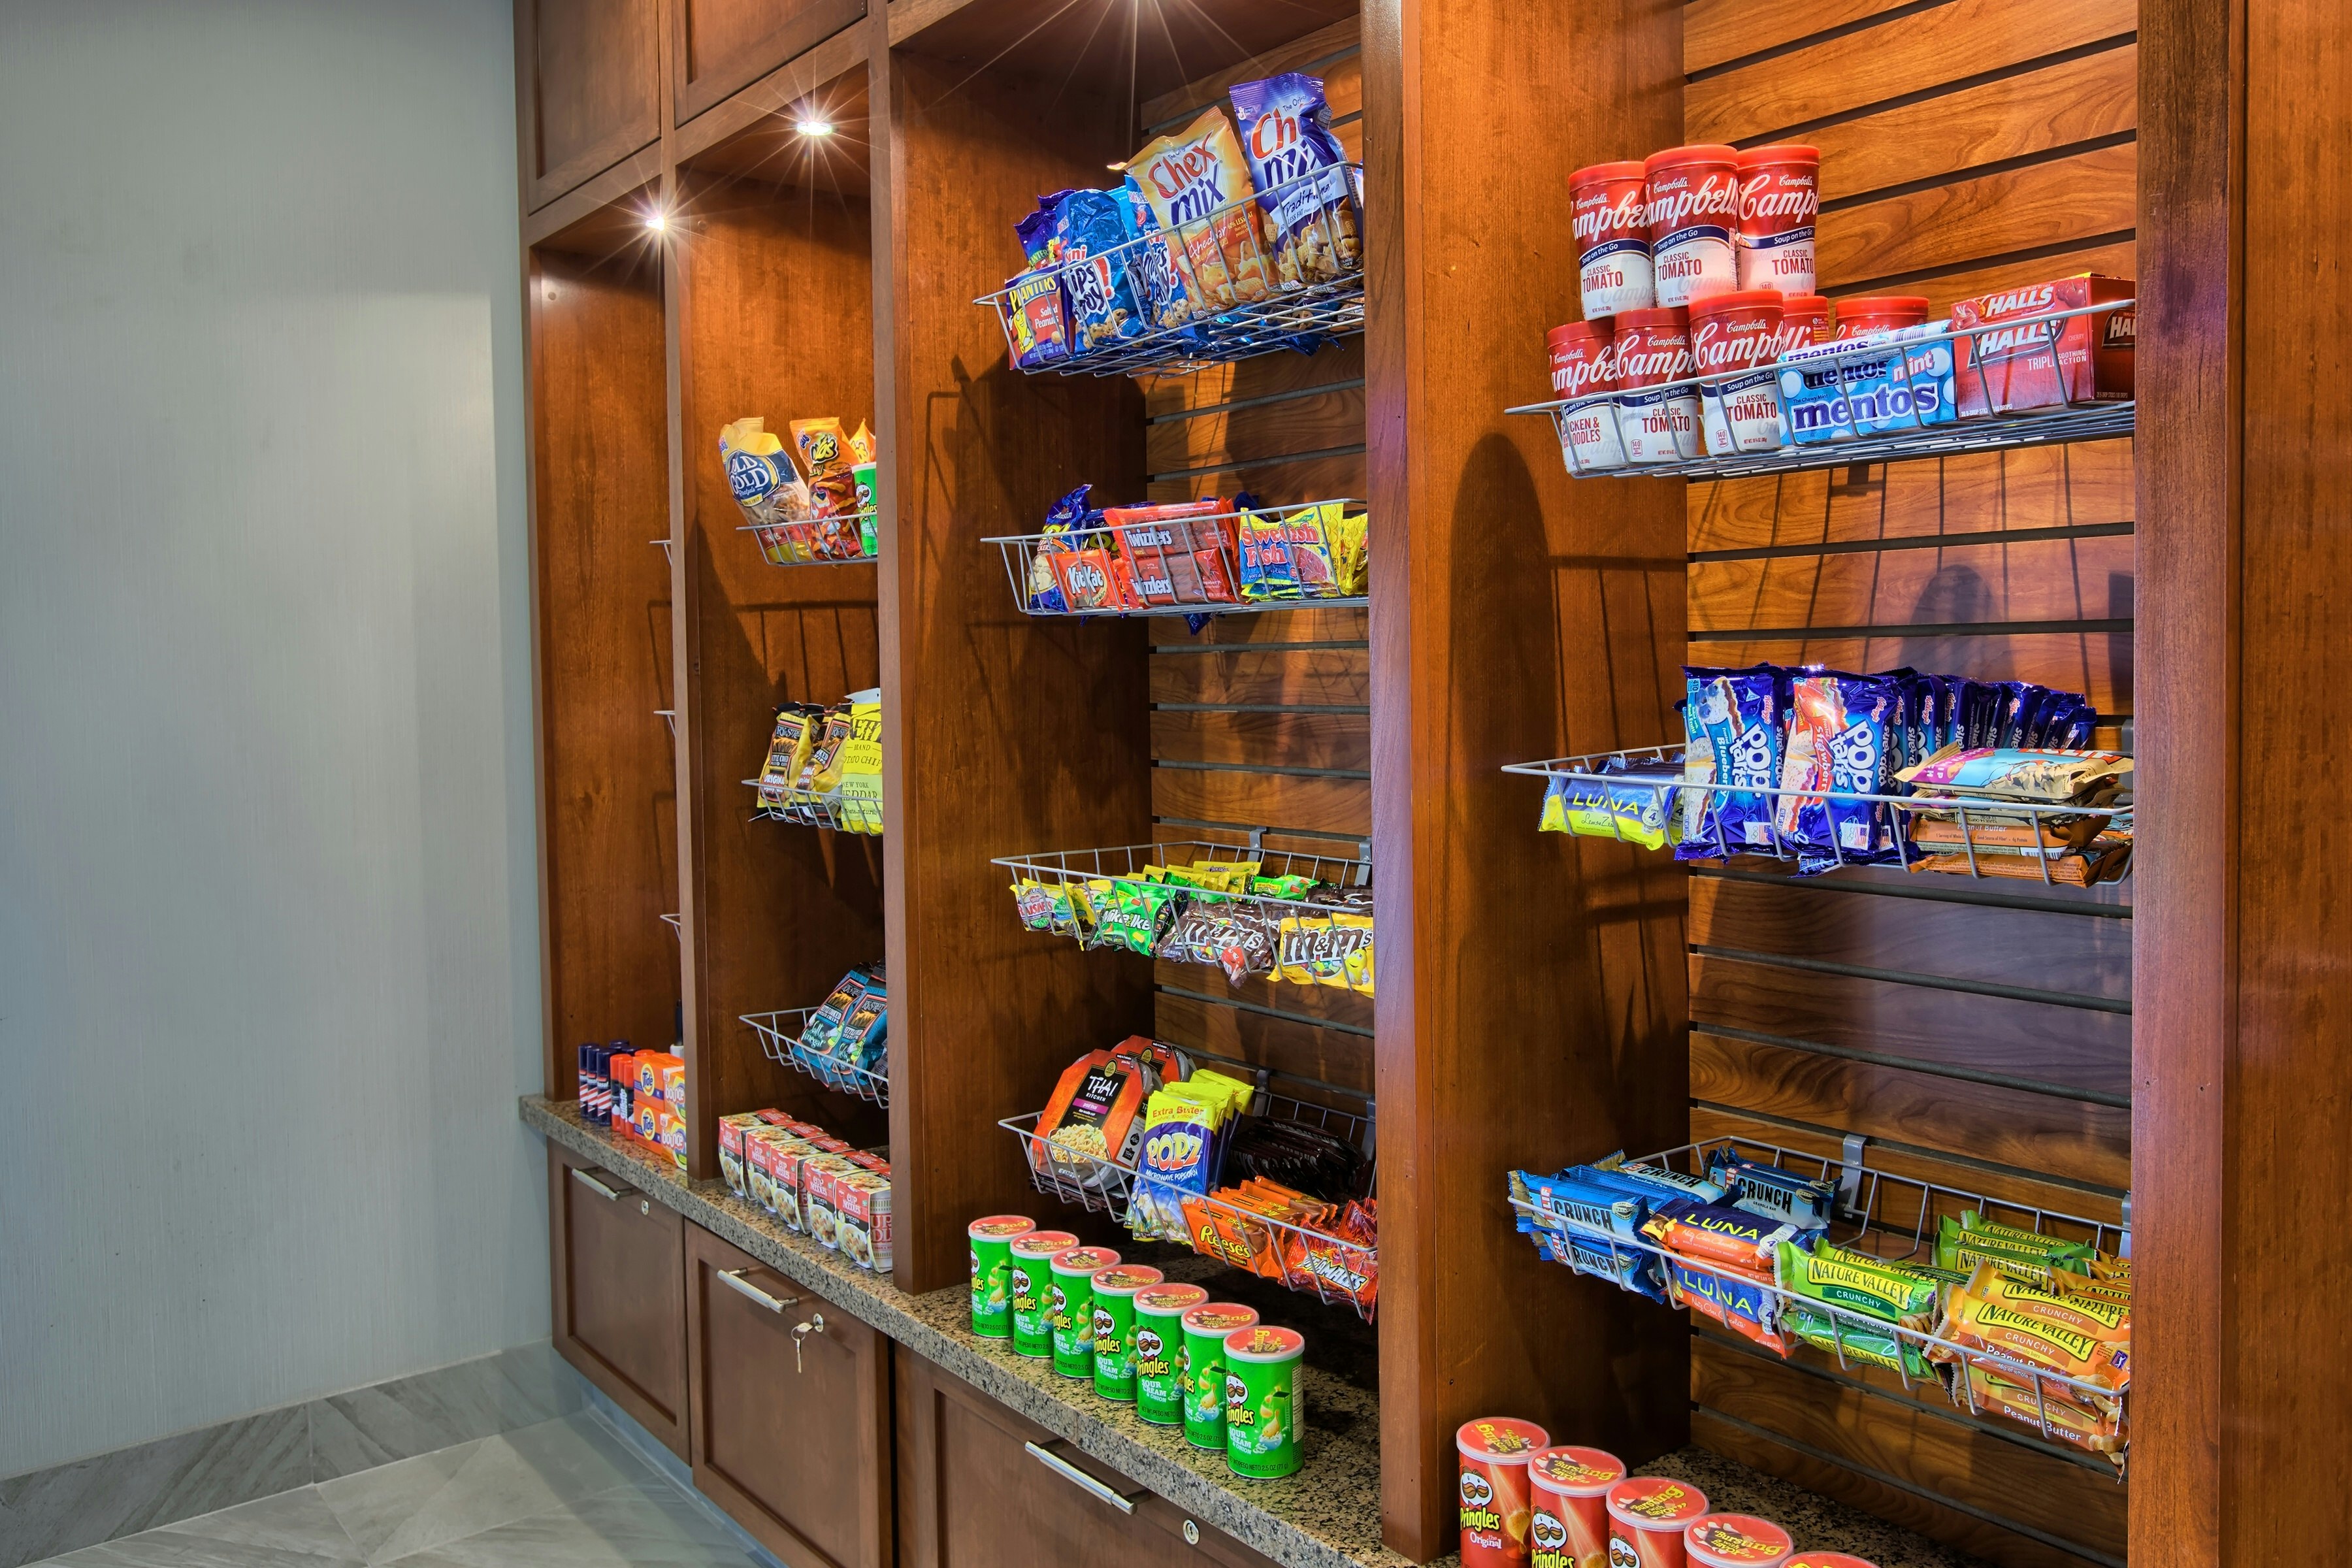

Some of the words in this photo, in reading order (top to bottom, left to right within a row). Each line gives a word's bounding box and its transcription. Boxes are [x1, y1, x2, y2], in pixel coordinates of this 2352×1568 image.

[1149, 131, 1217, 201] Chex
[1171, 163, 1225, 231] mix
[1658, 239, 1668, 251] Soup
[1669, 237, 1676, 245] on
[1677, 232, 1687, 241] the
[1774, 235, 1790, 244] Soup
[1582, 256, 1590, 265] Soup
[1599, 246, 1608, 255] the
[1663, 252, 1689, 263] CLASSIC
[1783, 250, 1808, 258] CLASSIC
[1587, 265, 1610, 276] CLASSIC
[1658, 258, 1703, 282] TOMATO
[1772, 258, 1814, 276] TOMATO
[1583, 271, 1623, 293] TOMATO
[1985, 286, 2054, 318] HALLS
[1979, 321, 2057, 357] HALLS
[2058, 350, 2086, 359] SOOTHING
[2059, 355, 2087, 365] ACTION
[1727, 382, 1743, 391] Soup
[1754, 374, 1764, 383] the
[1737, 394, 1767, 404] CLASSIC
[1792, 383, 1939, 431] mentos
[1727, 402, 1777, 422] TOMATO
[1593, 417, 1599, 427] &
[1642, 416, 1690, 433] TOMATO
[730, 469, 769, 494] GOLD
[1241, 523, 1319, 546] Swedish
[1246, 543, 1287, 567] Fish
[1572, 792, 1639, 815] LUNA
[1648, 812, 1657, 822] 4
[1130, 914, 1152, 930] Ike
[642, 1072, 653, 1087] Tide
[1087, 1075, 1118, 1096] THAI
[1086, 1093, 1106, 1102] KITCHEN
[1152, 1108, 1173, 1118] Extra
[643, 1116, 653, 1132] Tide
[1146, 1132, 1203, 1171] POPZ
[1146, 1169, 1174, 1181] MICROWAVE
[1175, 1169, 1198, 1181] POPCORN
[1638, 1168, 1701, 1188] CRUNCH
[846, 1194, 857, 1205] CUP
[1737, 1178, 1793, 1215] CRUNCH
[1753, 1200, 1768, 1209] GRANOLA
[1554, 1200, 1616, 1233] CRUNCH
[1684, 1214, 1758, 1239] LUNA
[1200, 1225, 1251, 1258] Reese's
[1812, 1260, 1861, 1285] NATURE
[1863, 1274, 1909, 1306] VALLEY
[1684, 1271, 1753, 1315] LUNA
[1837, 1290, 1881, 1308] CRUNCHY
[1846, 1301, 1862, 1311] granola
[1015, 1314, 1030, 1323] SOUR
[2033, 1305, 2084, 1325] CRUNCHY
[2040, 1316, 2058, 1327] granola
[1983, 1305, 2038, 1329] NATURE
[2042, 1324, 2092, 1356] VALLEY
[2005, 1332, 2055, 1356] CRUNCHY
[2014, 1346, 2029, 1355] granola
[1096, 1356, 1113, 1365] SOUR
[1986, 1345, 2023, 1364] Peanut
[1098, 1363, 1118, 1374] CREAM
[1104, 1369, 1118, 1380] ONION
[1137, 1358, 1169, 1378] Pringles
[2014, 1369, 2028, 1378] whole
[1141, 1379, 1162, 1388] SOUR
[1143, 1386, 1167, 1396] CREAM
[1151, 1394, 1167, 1403] ONION
[2004, 1405, 2041, 1428] Peanut
[2045, 1422, 2081, 1441] Butter
[1229, 1427, 1247, 1439] SOUR
[1230, 1435, 1252, 1448] CREAM
[1237, 1445, 1252, 1454] ONION
[1460, 1507, 1501, 1531] Pringles
[1470, 1531, 1502, 1549] Original
